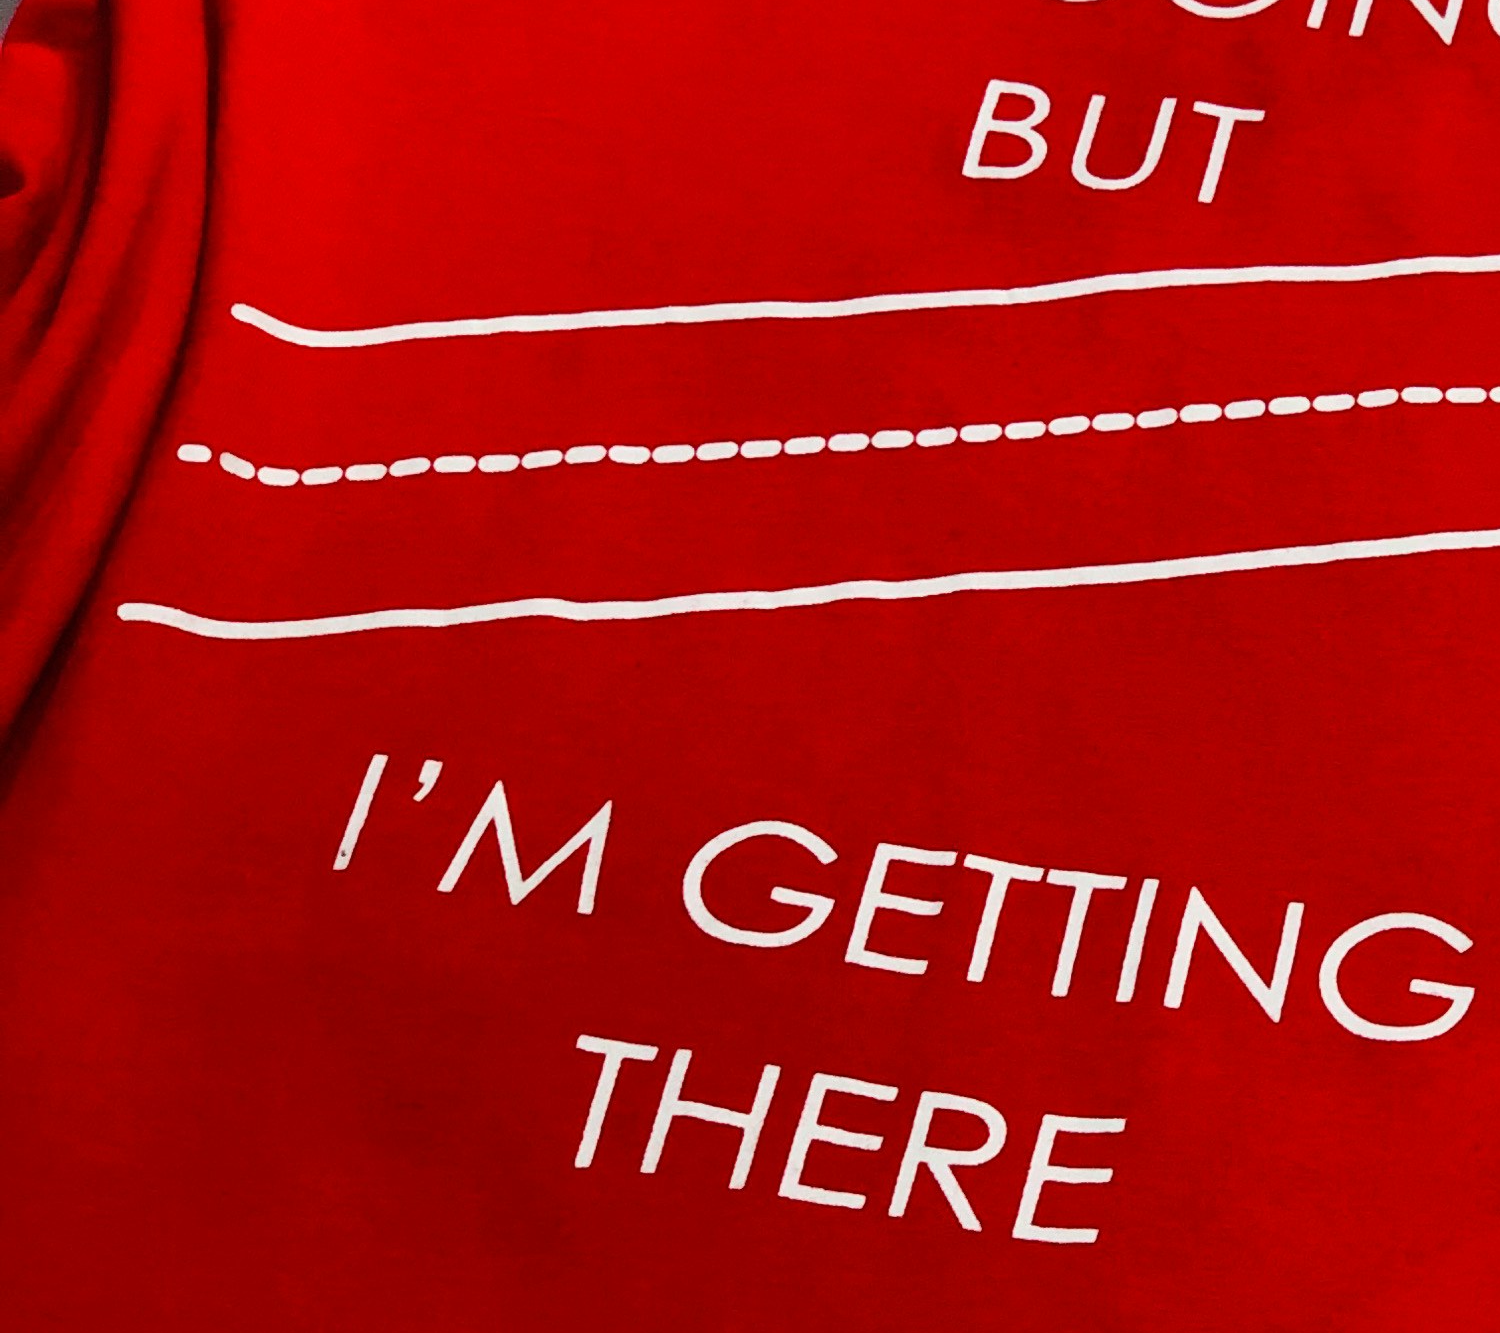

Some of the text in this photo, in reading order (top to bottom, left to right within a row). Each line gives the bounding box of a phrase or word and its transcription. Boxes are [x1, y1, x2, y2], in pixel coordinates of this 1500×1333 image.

[960, 78, 1267, 205] BUT
[331, 752, 1476, 1043] I'M GETTING
[573, 1033, 1128, 1245] THERE
